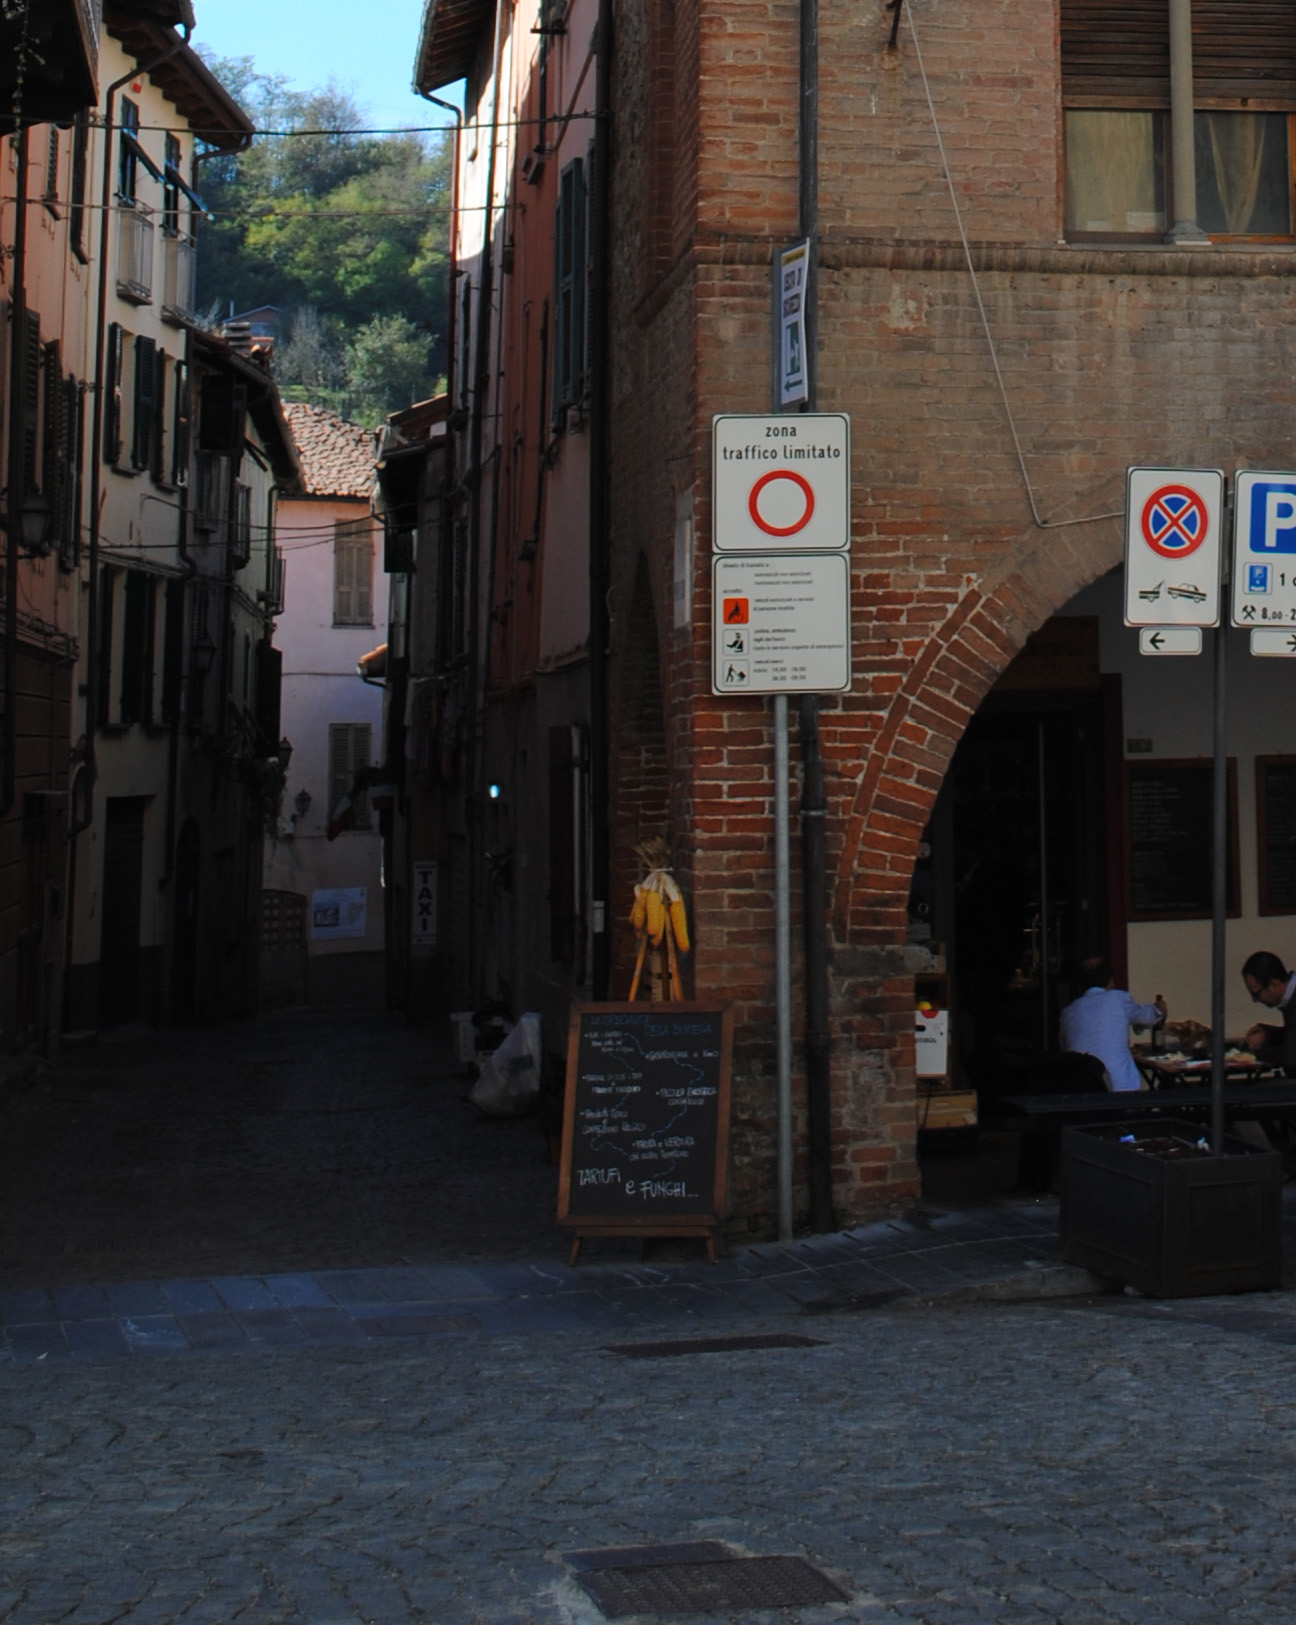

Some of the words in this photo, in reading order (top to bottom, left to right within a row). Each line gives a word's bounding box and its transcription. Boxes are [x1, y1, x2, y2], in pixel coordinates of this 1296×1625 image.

[765, 426, 798, 438] zona
[723, 444, 778, 461] traffico
[783, 444, 841, 460] limitato
[1279, 573, 1285, 587] 1
[418, 870, 433, 932] TAXI
[577, 1167, 621, 1186] TARTUFI
